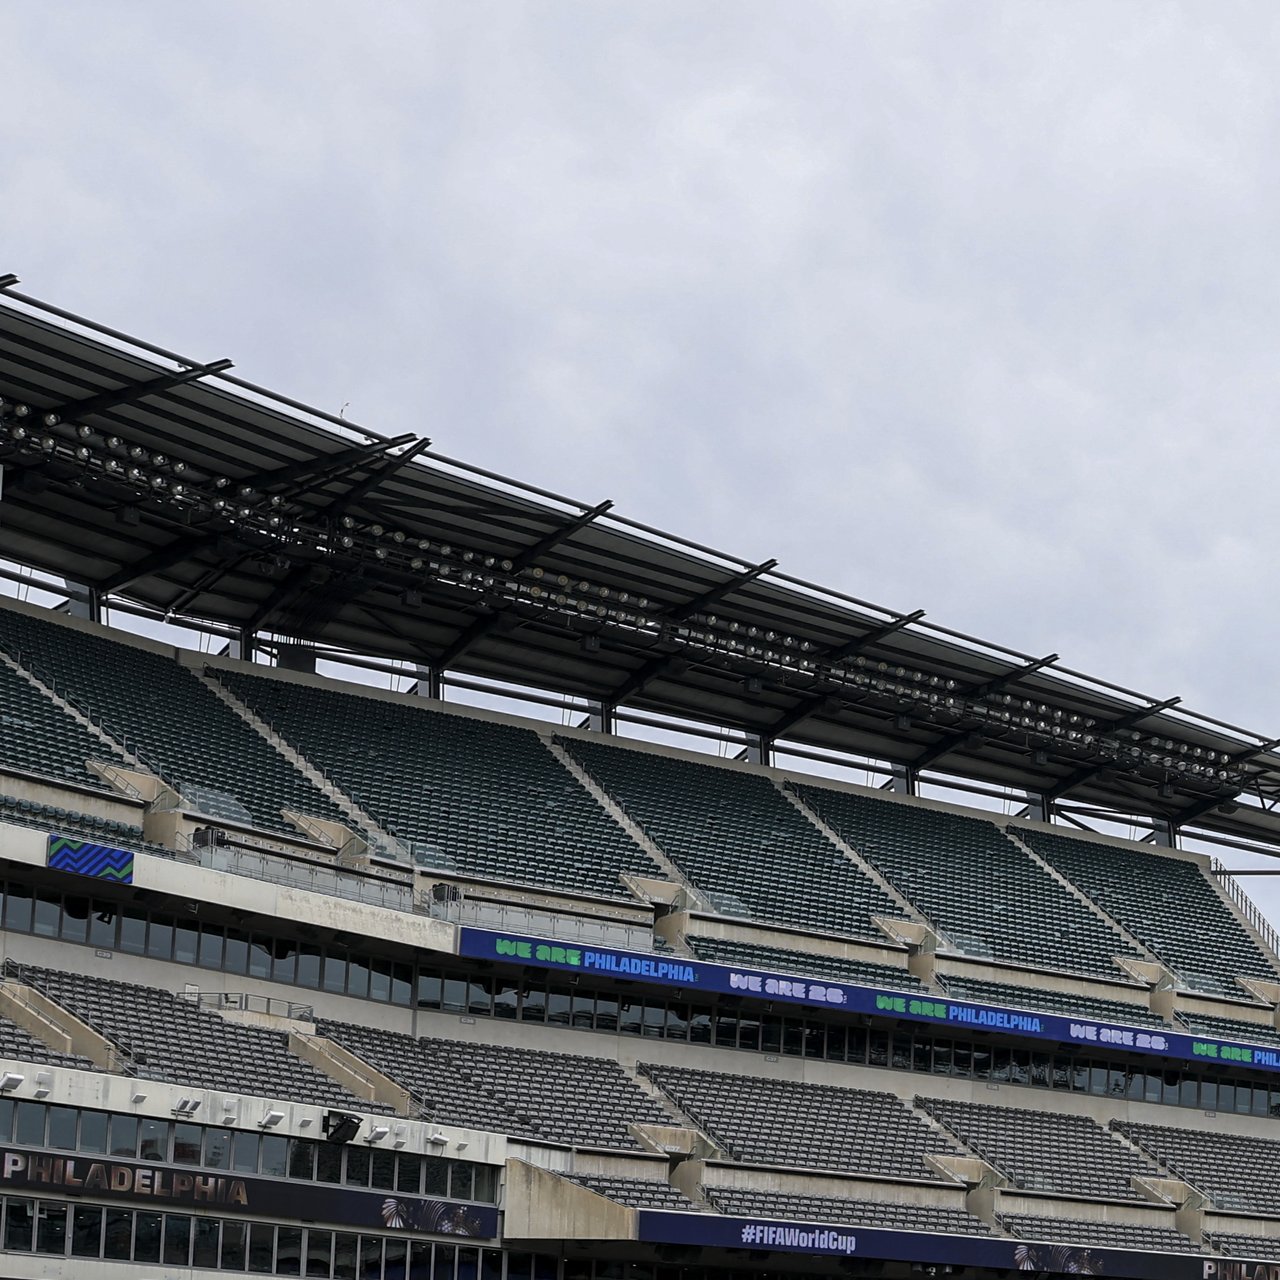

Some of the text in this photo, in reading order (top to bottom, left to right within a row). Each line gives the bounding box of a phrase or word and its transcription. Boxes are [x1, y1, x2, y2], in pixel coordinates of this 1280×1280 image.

[495, 938, 531, 958] WE
[536, 946, 581, 966] ARE
[584, 951, 694, 982] PHILADELPHIA
[730, 972, 762, 991] WE
[764, 978, 805, 998] ARE
[809, 984, 844, 1004] 26
[876, 994, 1041, 1032] WE ARE PHILADELPHIA
[1070, 1022, 1165, 1051] WE ARE 26
[1193, 1041, 1218, 1058] WE
[1221, 1045, 1252, 1063] ARE
[3, 1152, 248, 1206] PHILADELPHIA
[742, 1224, 856, 1254] #FIFAWorldCup
